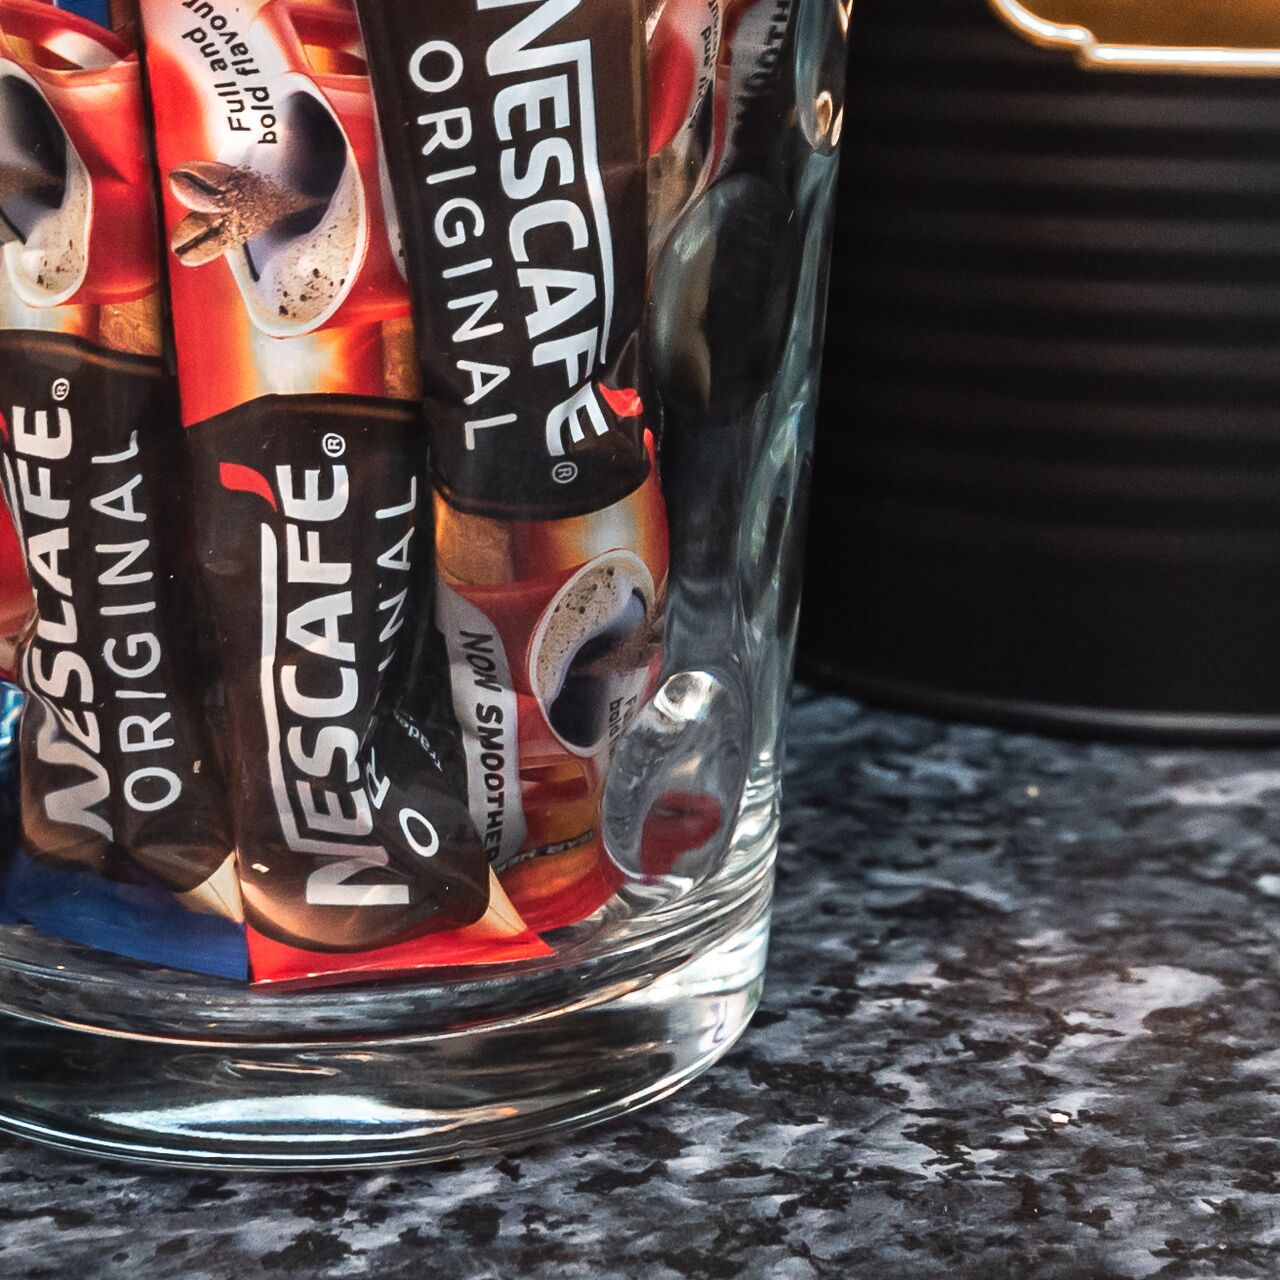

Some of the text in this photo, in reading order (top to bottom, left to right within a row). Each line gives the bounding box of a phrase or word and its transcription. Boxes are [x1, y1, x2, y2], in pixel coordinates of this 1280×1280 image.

[181, 26, 252, 132] Full and
[244, 86, 278, 144] bold
[408, 38, 518, 451] ORIGINAL
[92, 428, 183, 812] ORIGINAL
[460, 629, 503, 694] NOW
